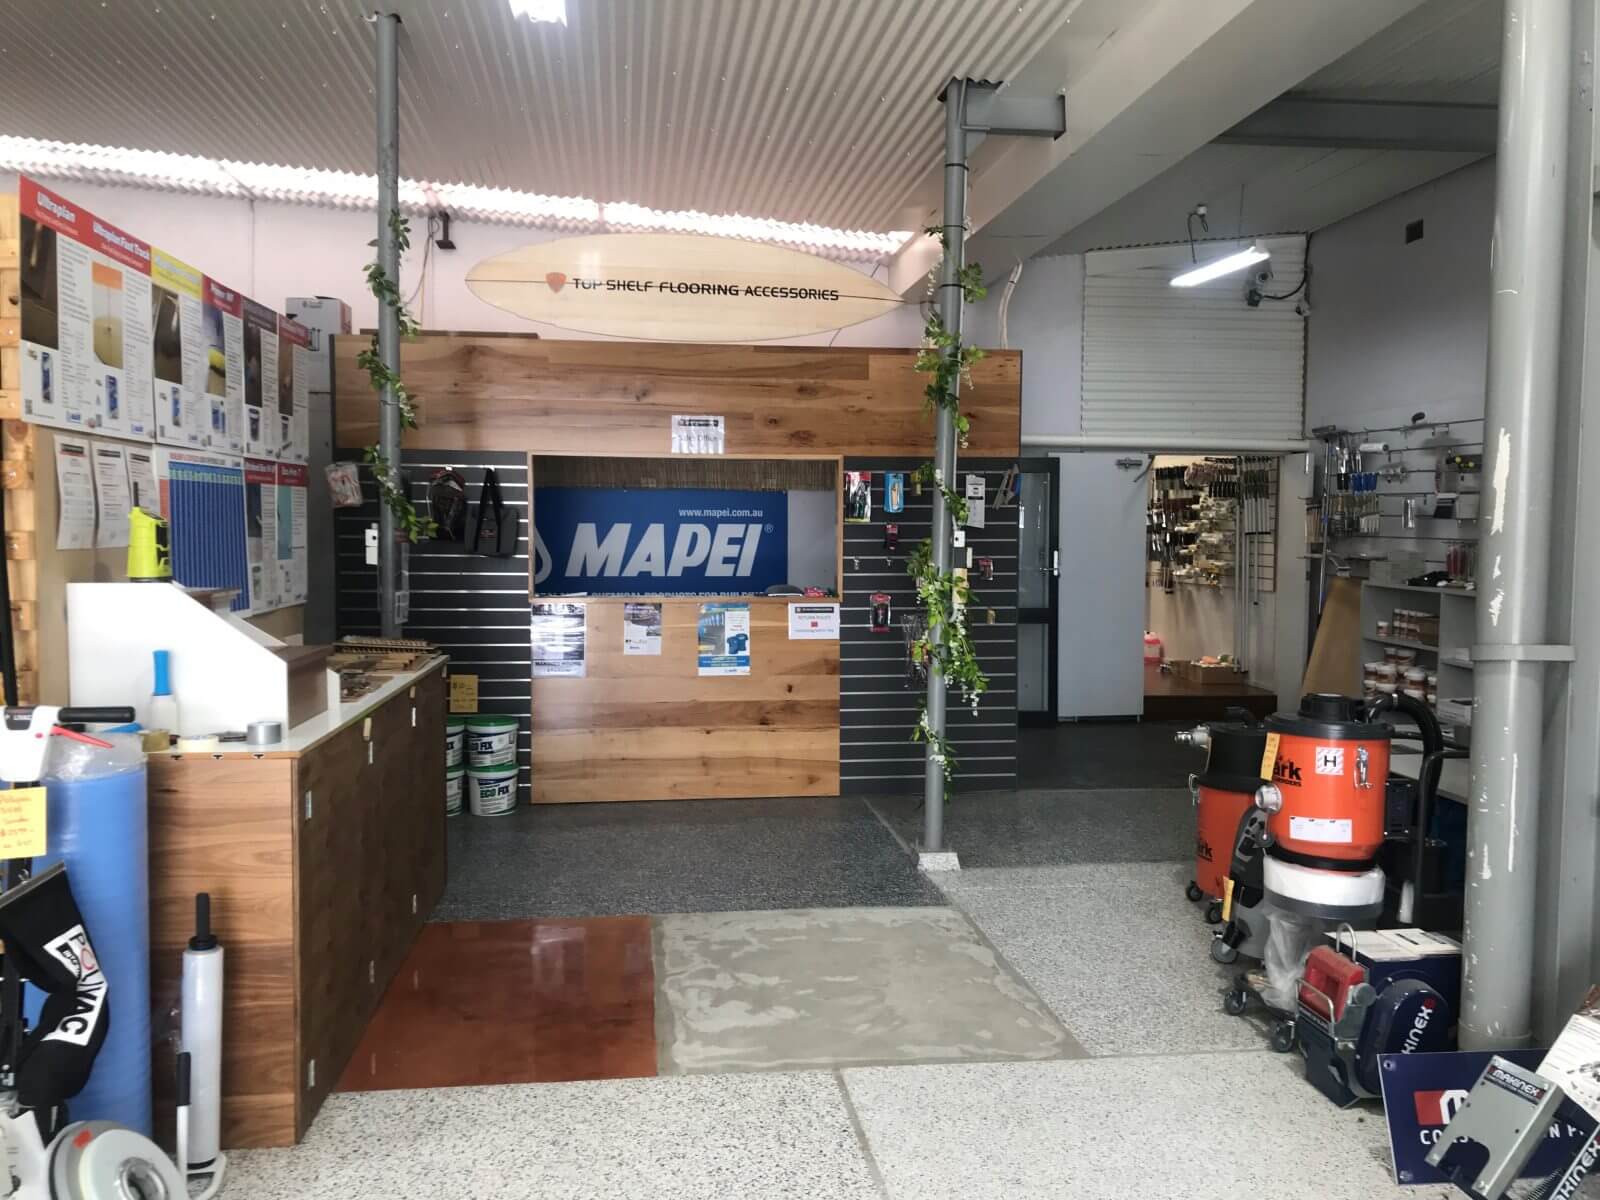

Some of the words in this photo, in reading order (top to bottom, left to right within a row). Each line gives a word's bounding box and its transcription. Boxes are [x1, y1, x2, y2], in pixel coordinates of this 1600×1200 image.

[606, 279, 654, 292] SHELF
[659, 281, 739, 297] FLOORING
[744, 285, 840, 301] ACCESSORIES
[678, 507, 764, 519] www.mapei.com.au
[564, 522, 763, 577] MAPEI
[1324, 754, 1337, 767] H
[1400, 1004, 1434, 1055] KINEX
[1491, 1068, 1540, 1098] MAKINEX
